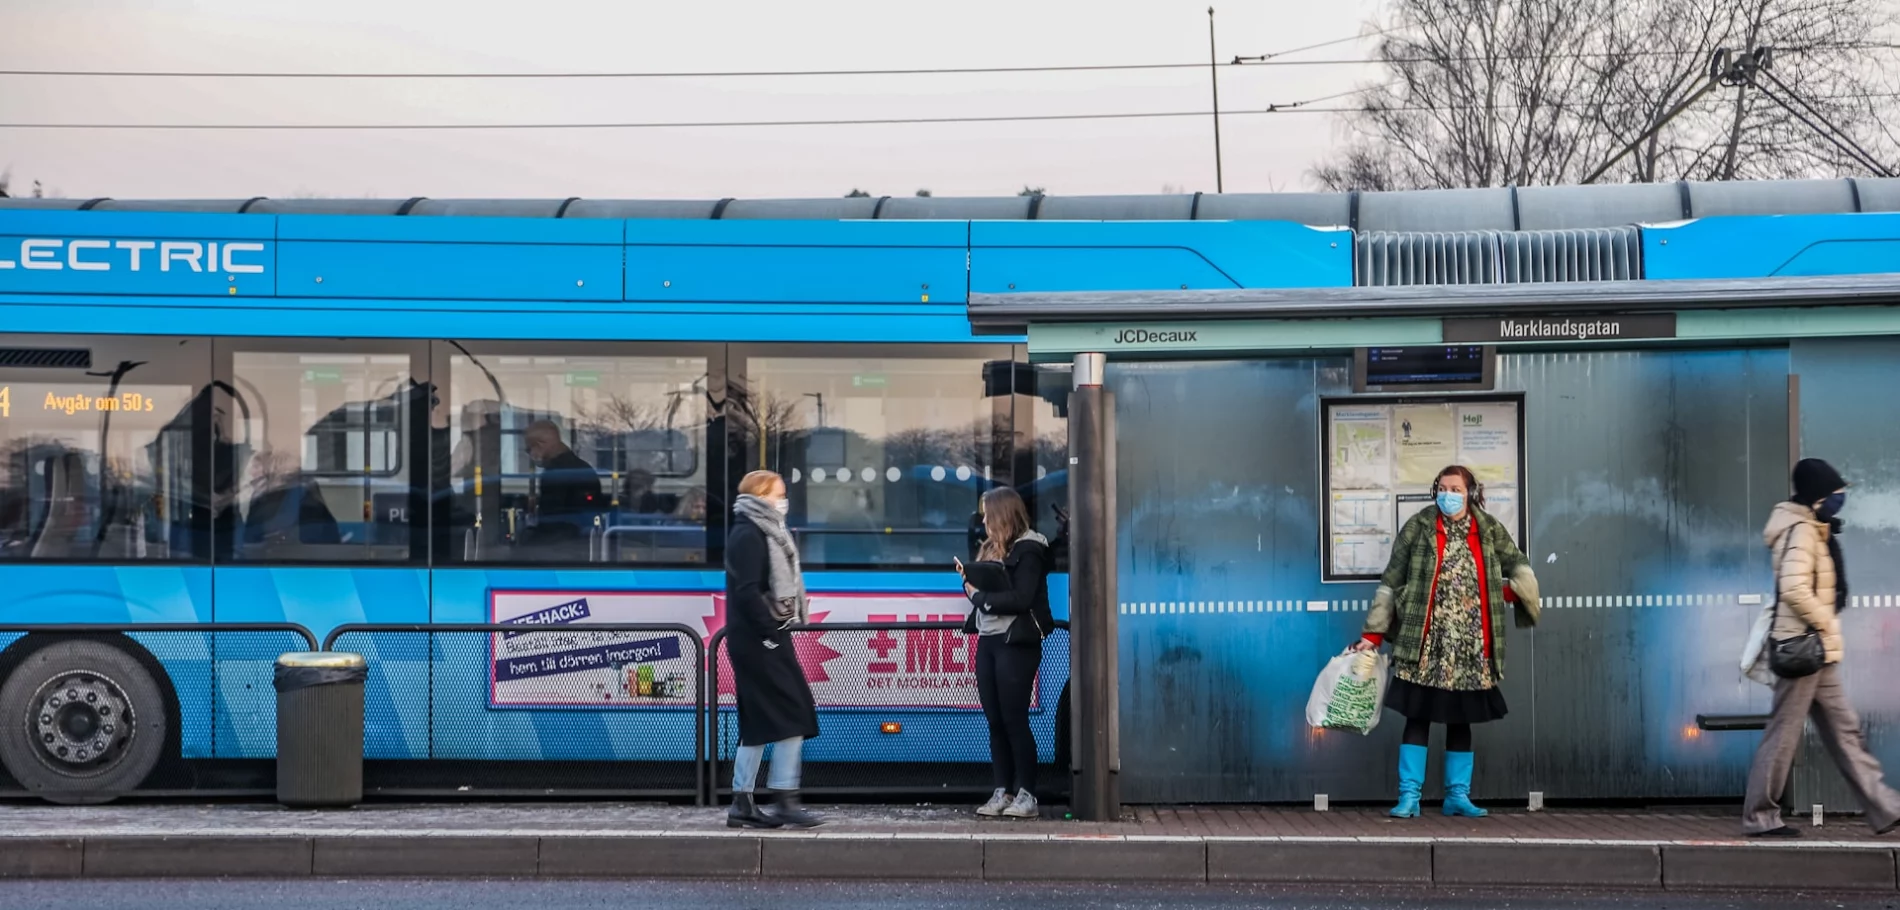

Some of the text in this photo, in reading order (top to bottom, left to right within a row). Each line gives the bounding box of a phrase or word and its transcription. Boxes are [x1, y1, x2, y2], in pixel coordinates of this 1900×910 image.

[0, 239, 264, 273] ECTRIC
[1114, 329, 1197, 344] JCDecaux
[1500, 318, 1620, 339] Marklandsgatan
[44, 391, 154, 415] Avgår om 50 s
[508, 603, 584, 635] E-HACK:
[509, 642, 662, 675] hem till dörren imorgon!
